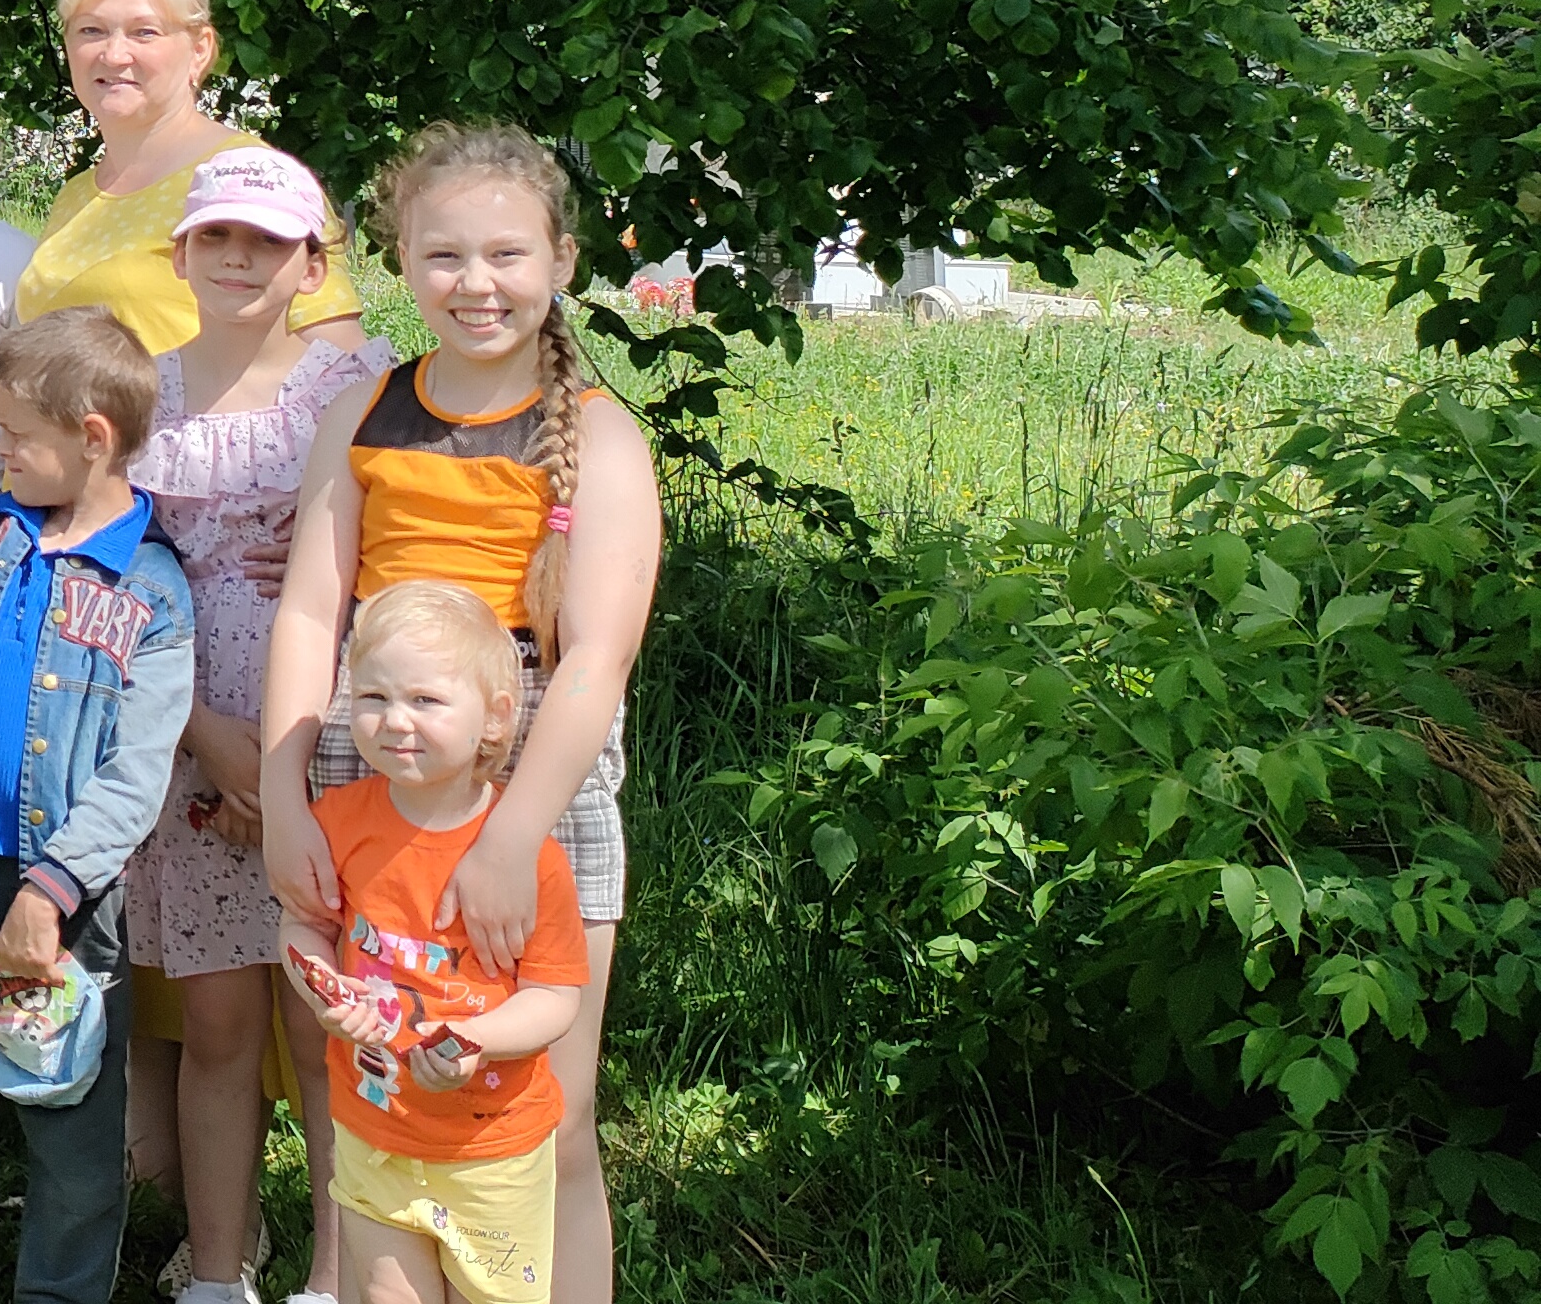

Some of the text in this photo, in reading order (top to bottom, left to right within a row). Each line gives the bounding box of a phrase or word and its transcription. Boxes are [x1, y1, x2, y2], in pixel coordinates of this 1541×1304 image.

[438, 982, 487, 1013] Dog
[456, 1226, 510, 1241] FOLLOW YOUR
